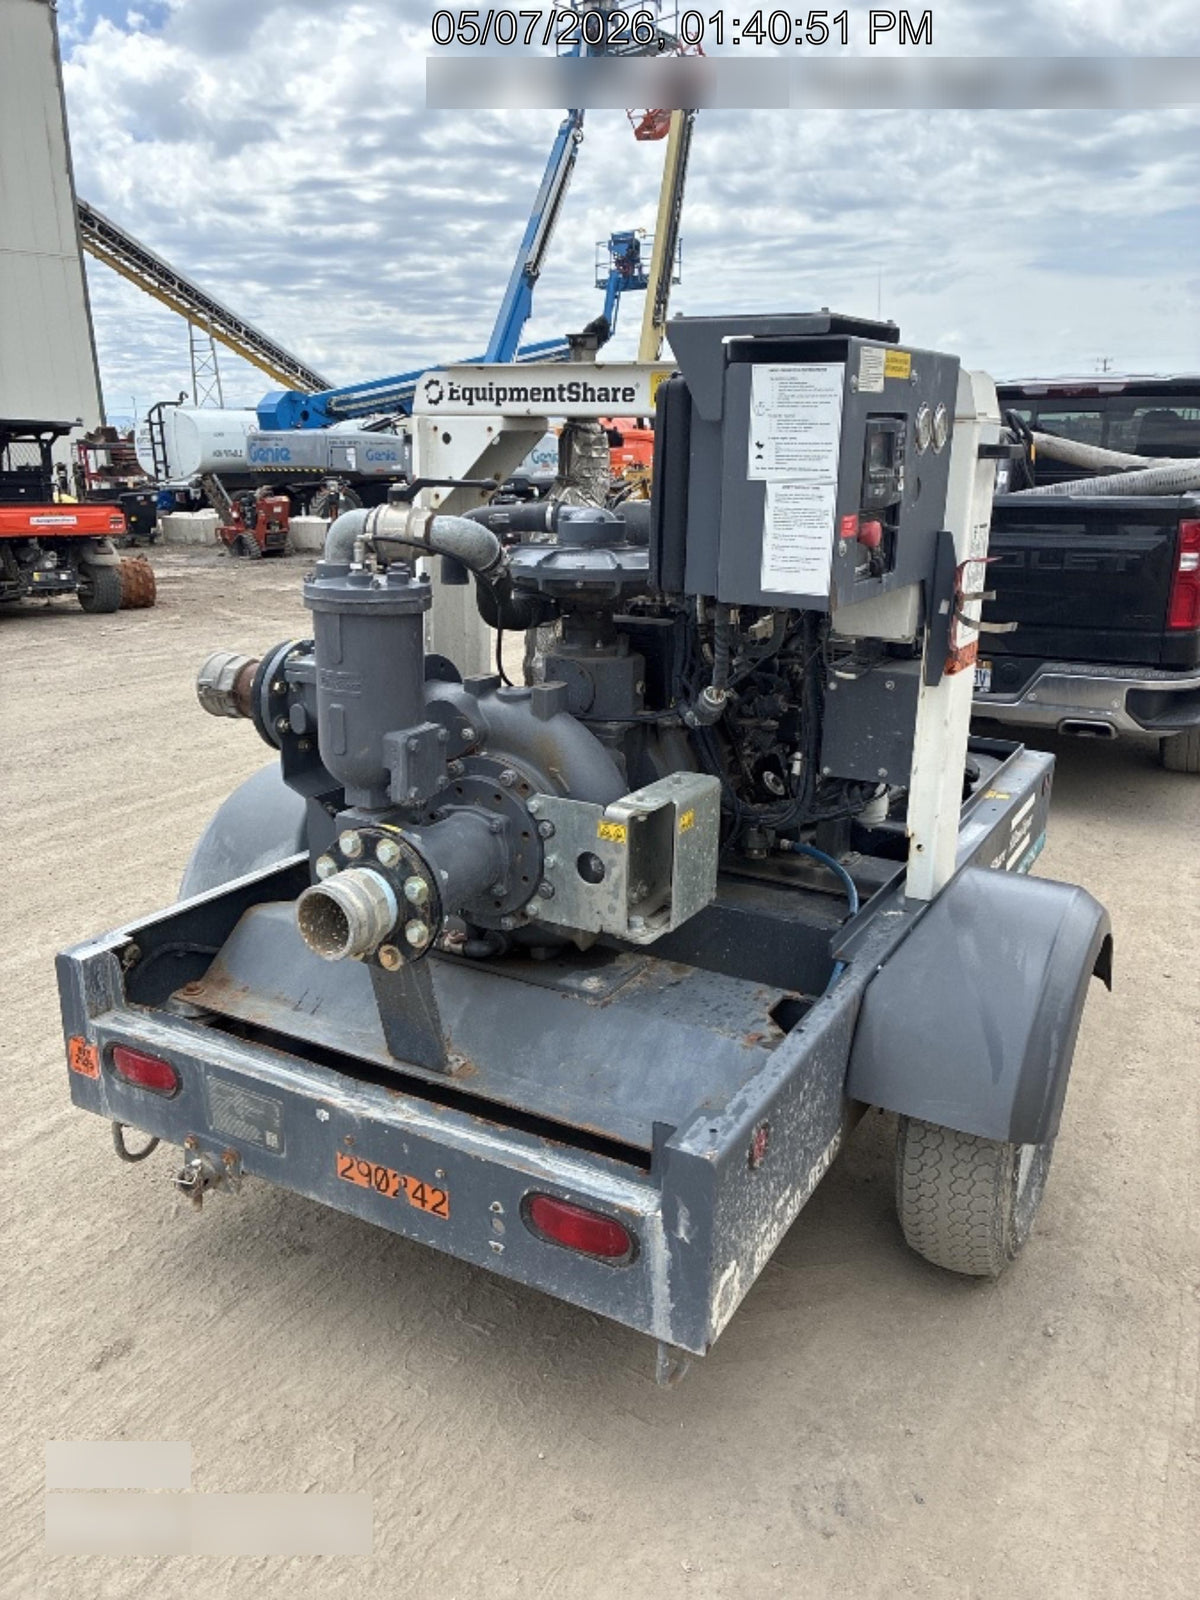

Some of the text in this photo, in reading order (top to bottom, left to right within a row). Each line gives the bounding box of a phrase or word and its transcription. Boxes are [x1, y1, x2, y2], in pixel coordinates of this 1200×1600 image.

[447, 381, 636, 406] EquipmentShare
[249, 442, 292, 463] Genie
[365, 448, 398, 462] Genie
[339, 1153, 447, 1217] 290242
